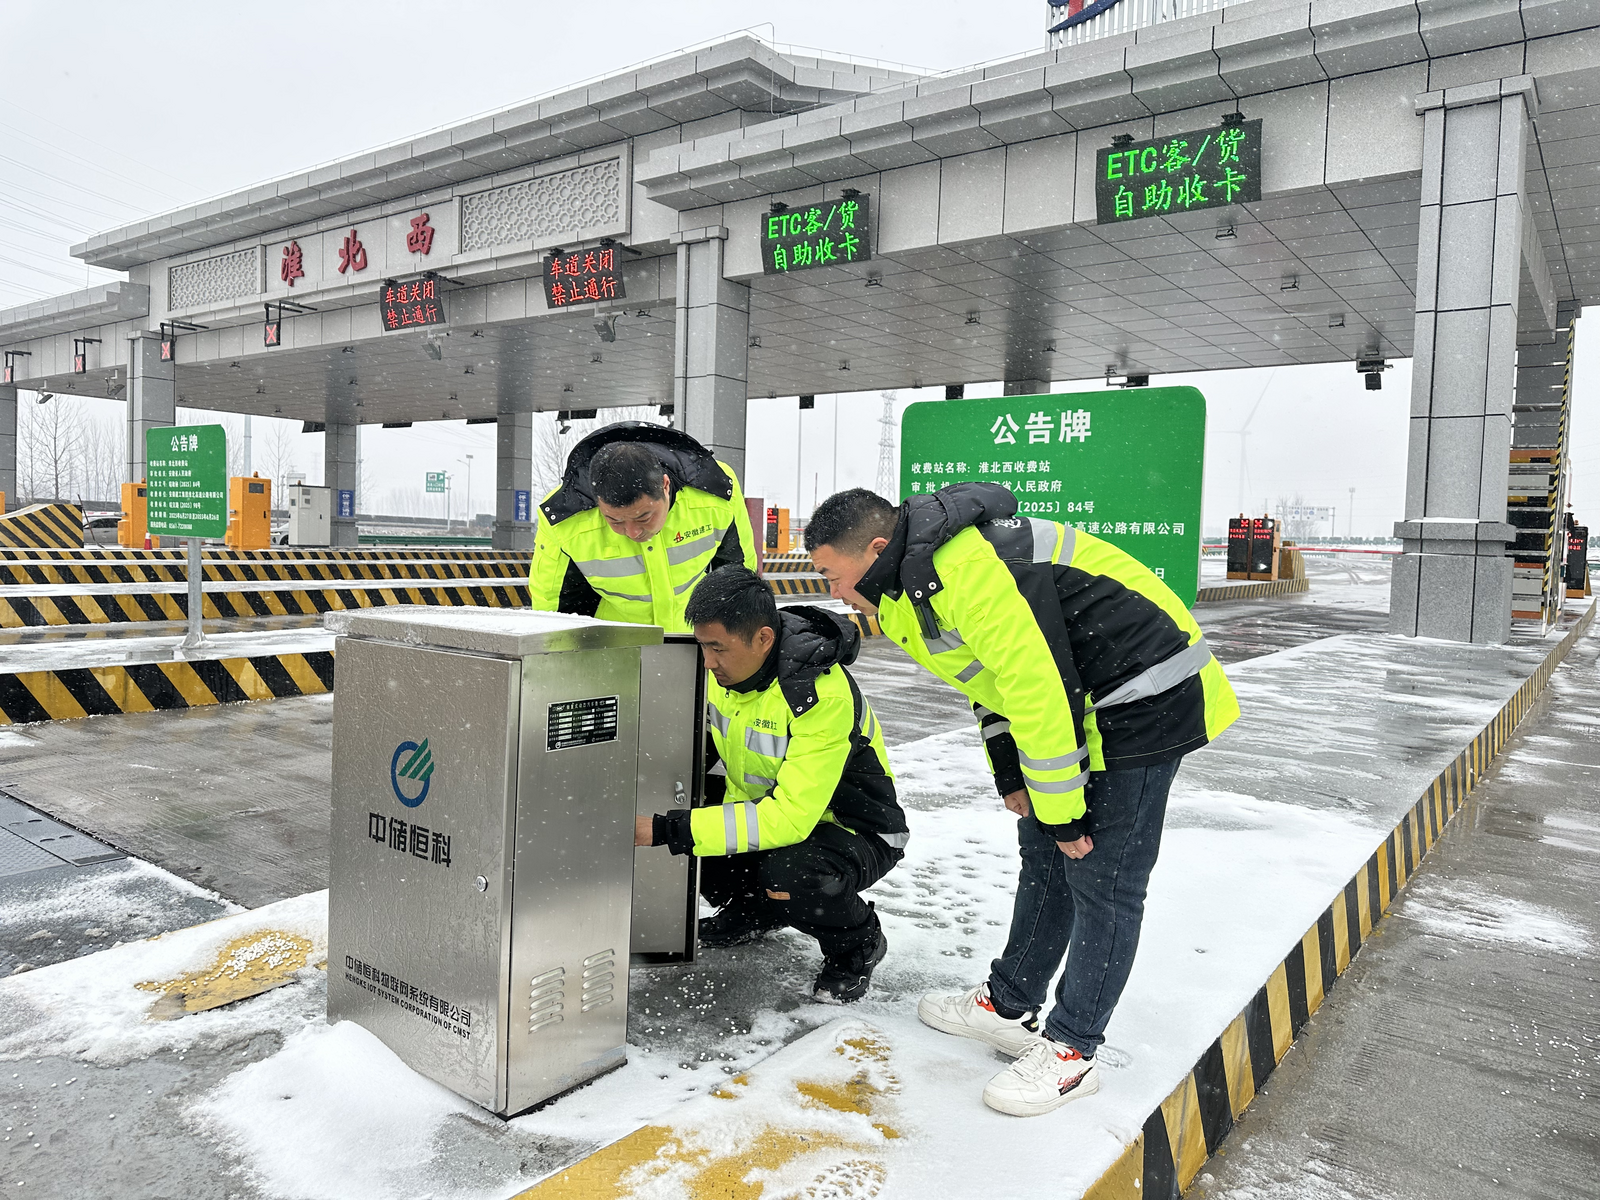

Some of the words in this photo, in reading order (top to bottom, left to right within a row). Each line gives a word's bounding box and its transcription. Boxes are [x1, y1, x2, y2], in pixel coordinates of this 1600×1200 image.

[1107, 128, 1246, 180] ETC客/货
[1114, 167, 1246, 217] 自助收卡
[768, 200, 860, 239] ETC客/货
[550, 249, 614, 279] 车道关闭
[773, 232, 860, 270] 自助收卡
[385, 279, 435, 306] 车道关闭
[551, 276, 617, 305] 禁止通行
[387, 303, 437, 329] 禁止通行
[171, 434, 198, 452] 公告牌
[990, 409, 1092, 445] 公告牌
[978, 460, 1051, 473] 淮北西收费站
[368, 812, 451, 868] 中储恒科
[345, 971, 367, 989] HENGKE
[377, 988, 399, 1005] SYSTEM
[400, 999, 443, 1026] CORPORATION
[443, 1020, 452, 1031] OF
[453, 1025, 470, 1040] CMST
[346, 955, 471, 1027] 中储恒科物联网系统有限公司
